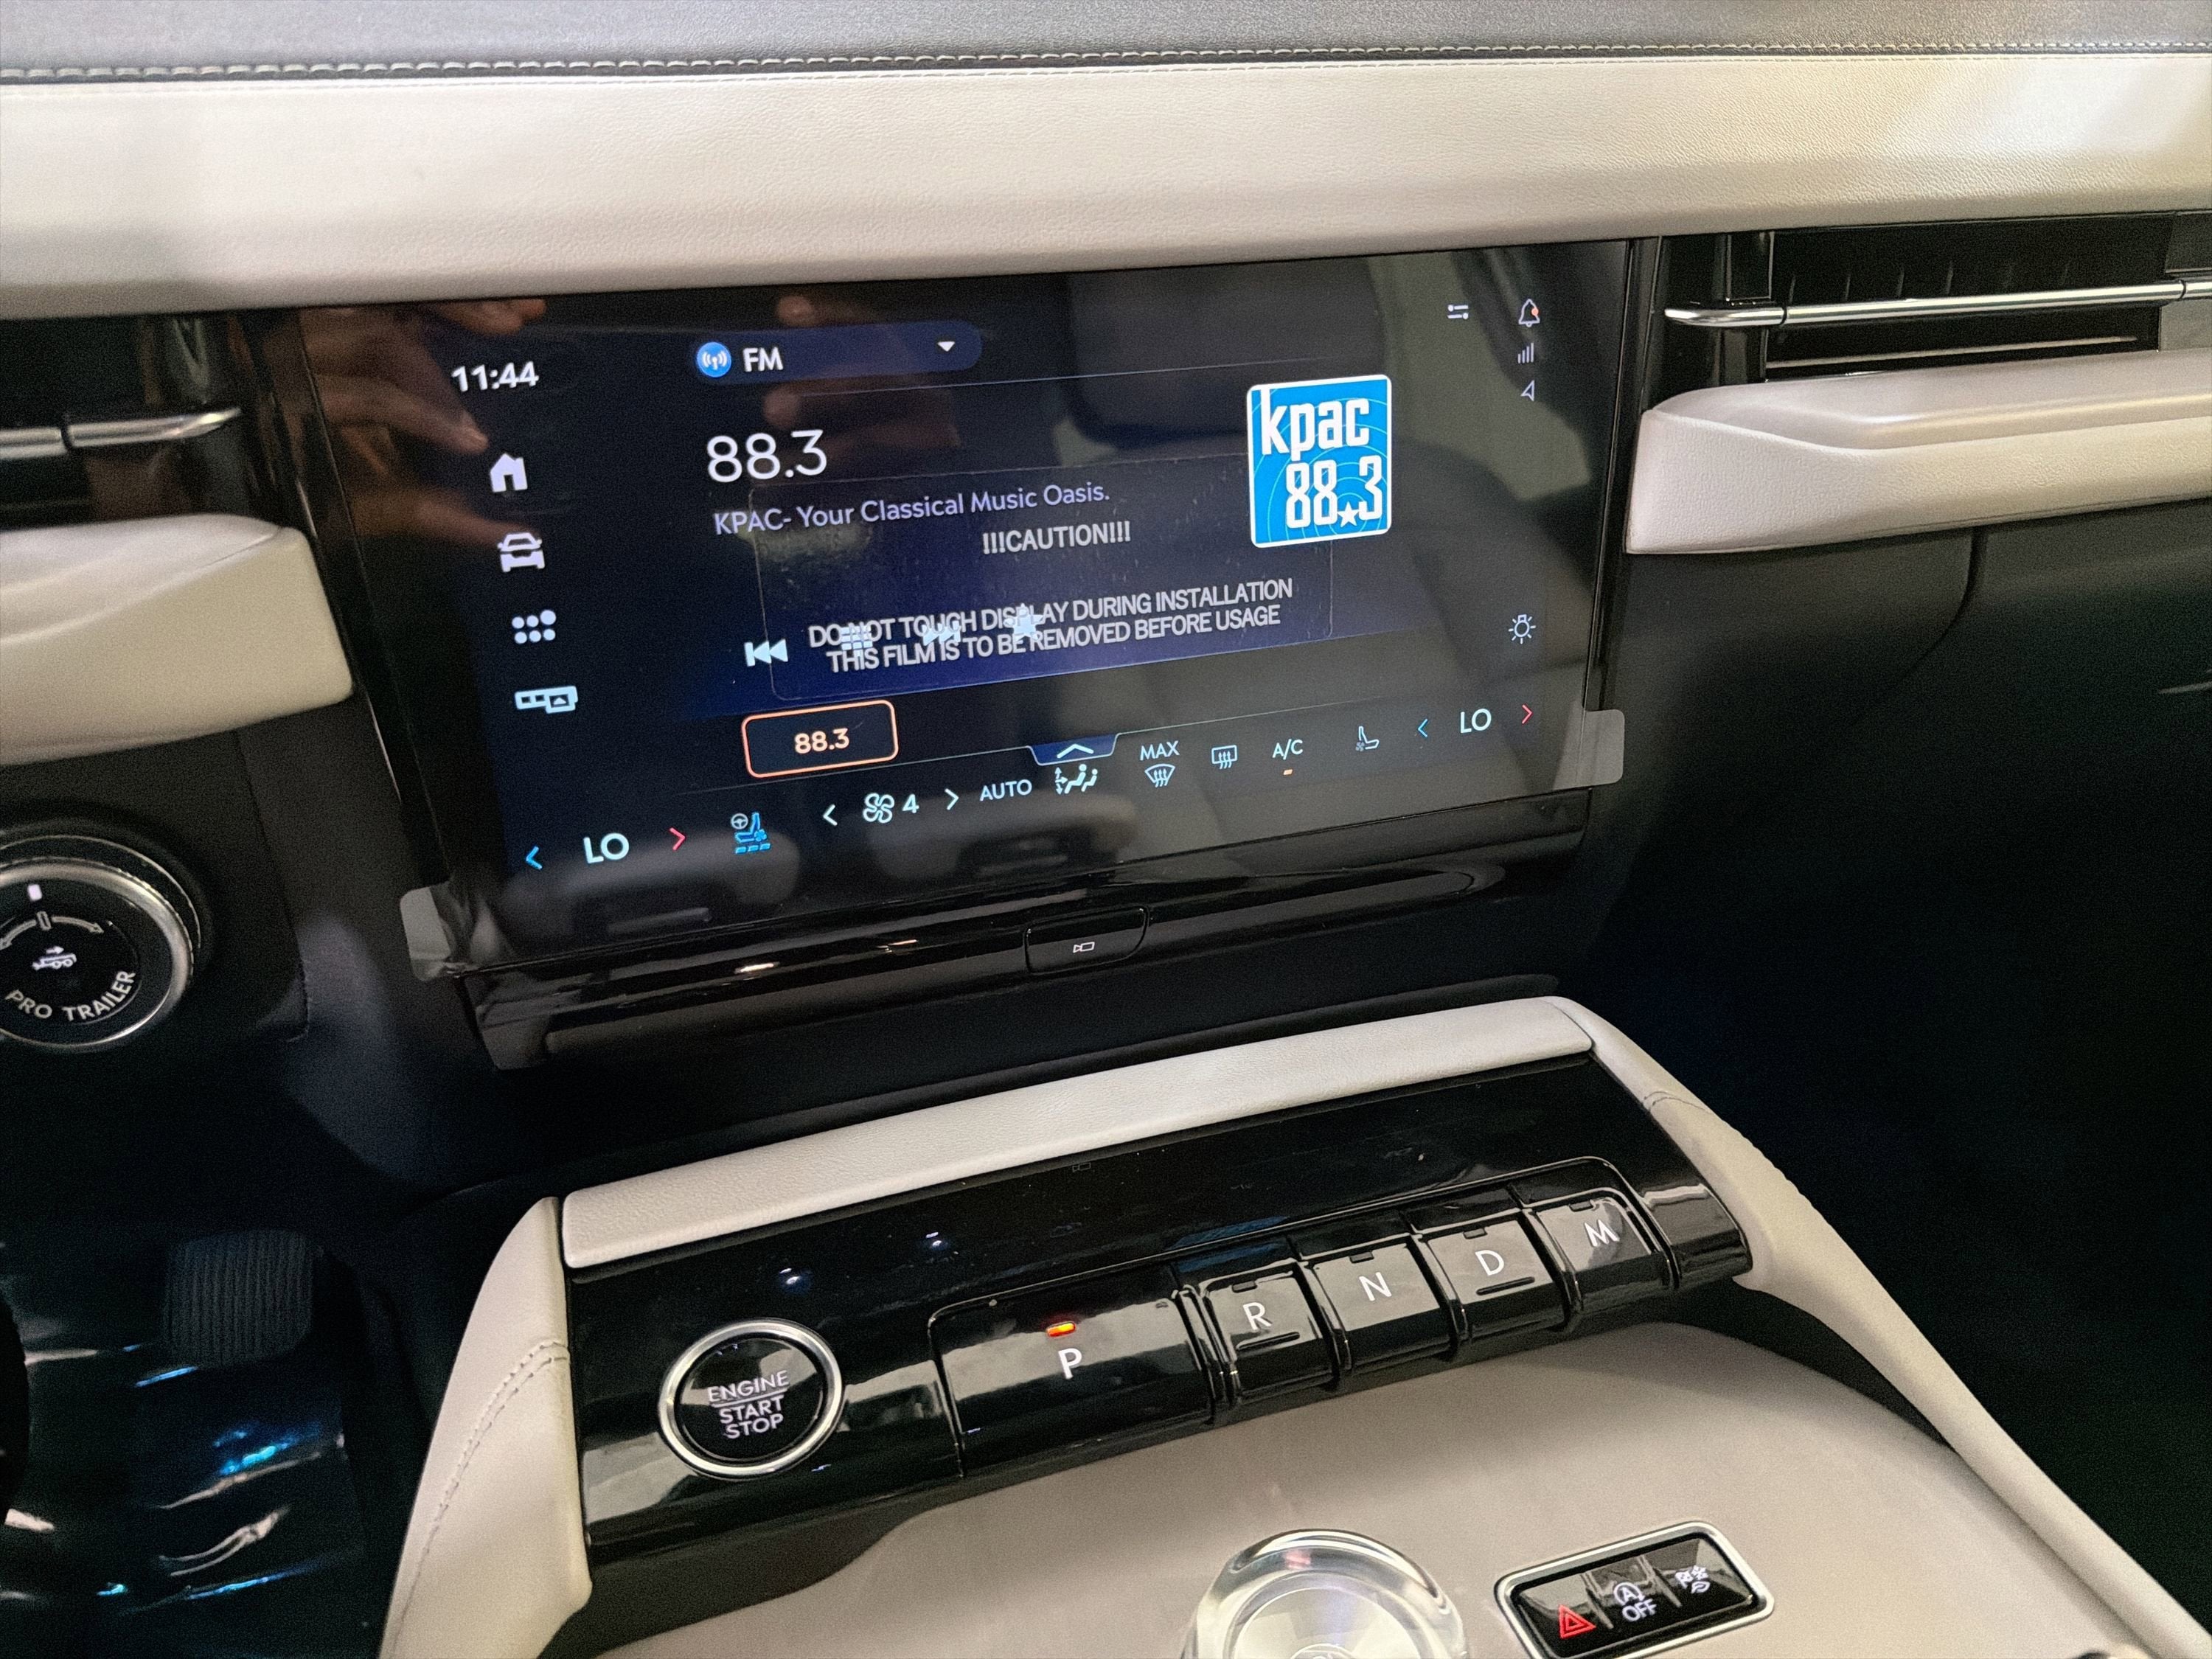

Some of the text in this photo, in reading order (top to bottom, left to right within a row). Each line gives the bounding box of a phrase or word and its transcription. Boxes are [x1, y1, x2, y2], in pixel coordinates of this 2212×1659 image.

[743, 347, 784, 372] FM
[451, 361, 540, 392] 11:44
[1259, 388, 1370, 461] kpac
[706, 428, 828, 484] 88.3
[714, 481, 1110, 535] KPAC- Your Classical Music Oasis.
[808, 623, 843, 648] DO
[898, 610, 978, 639] TOUCH
[1072, 593, 1152, 622] DURING
[1155, 577, 1293, 613] INSTALLATION
[825, 604, 1281, 673] THIS FILM IS TO BE REMOVED BEFORE USAGE
[1459, 708, 1492, 734] LO
[793, 728, 850, 754] 88.3
[1139, 740, 1180, 761] MAX
[1271, 738, 1304, 762] A/C
[901, 794, 920, 814] 4
[979, 779, 1032, 802] AUTO
[582, 832, 630, 865] LO
[5, 970, 137, 1023] PRO TRAILER
[1583, 1218, 1620, 1248] M
[1474, 1249, 1505, 1277] D
[1358, 1270, 1392, 1302] N
[1242, 1301, 1273, 1332] R
[1057, 1347, 1083, 1381] P
[708, 1370, 790, 1402] ENGINE
[718, 1394, 785, 1424] START
[724, 1413, 784, 1439] STOP
[1621, 1597, 1658, 1622] OFF
